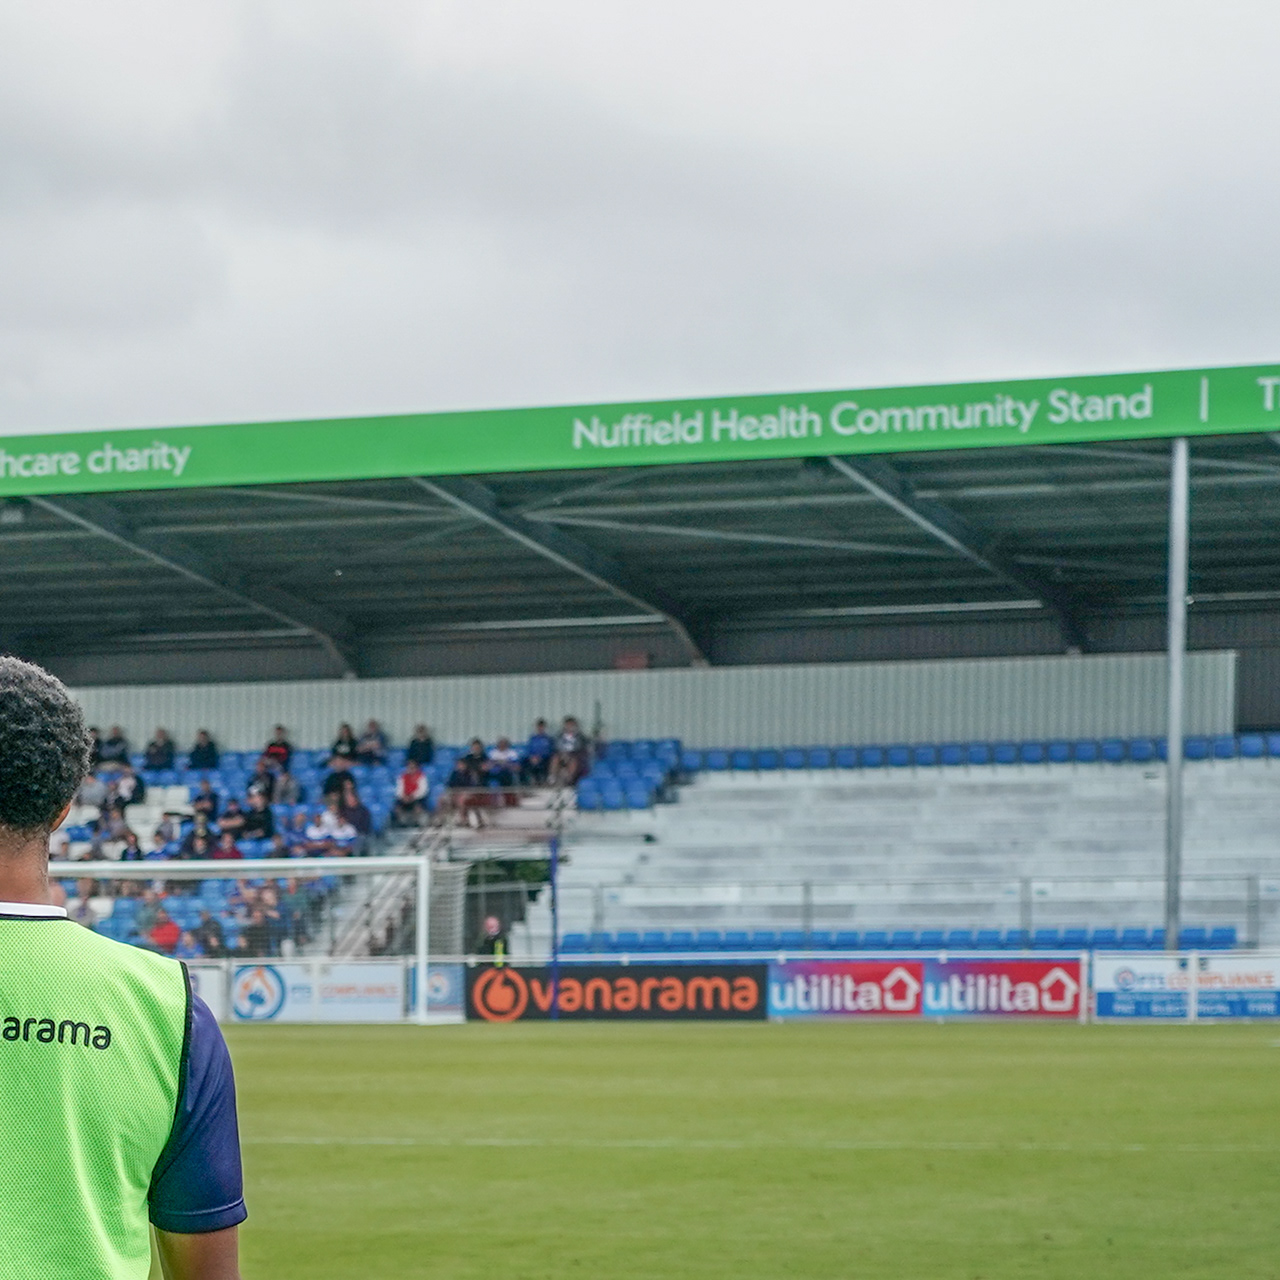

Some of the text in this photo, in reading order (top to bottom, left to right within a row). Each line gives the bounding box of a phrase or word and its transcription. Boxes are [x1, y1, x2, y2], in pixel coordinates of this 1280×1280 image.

[1256, 376, 1280, 411] T
[573, 385, 1152, 449] Nuffield Health Community Stand
[87, 440, 192, 477] charity
[530, 976, 759, 1012] vanarama
[770, 973, 884, 1012] utilita
[925, 973, 1040, 1012] utilita
